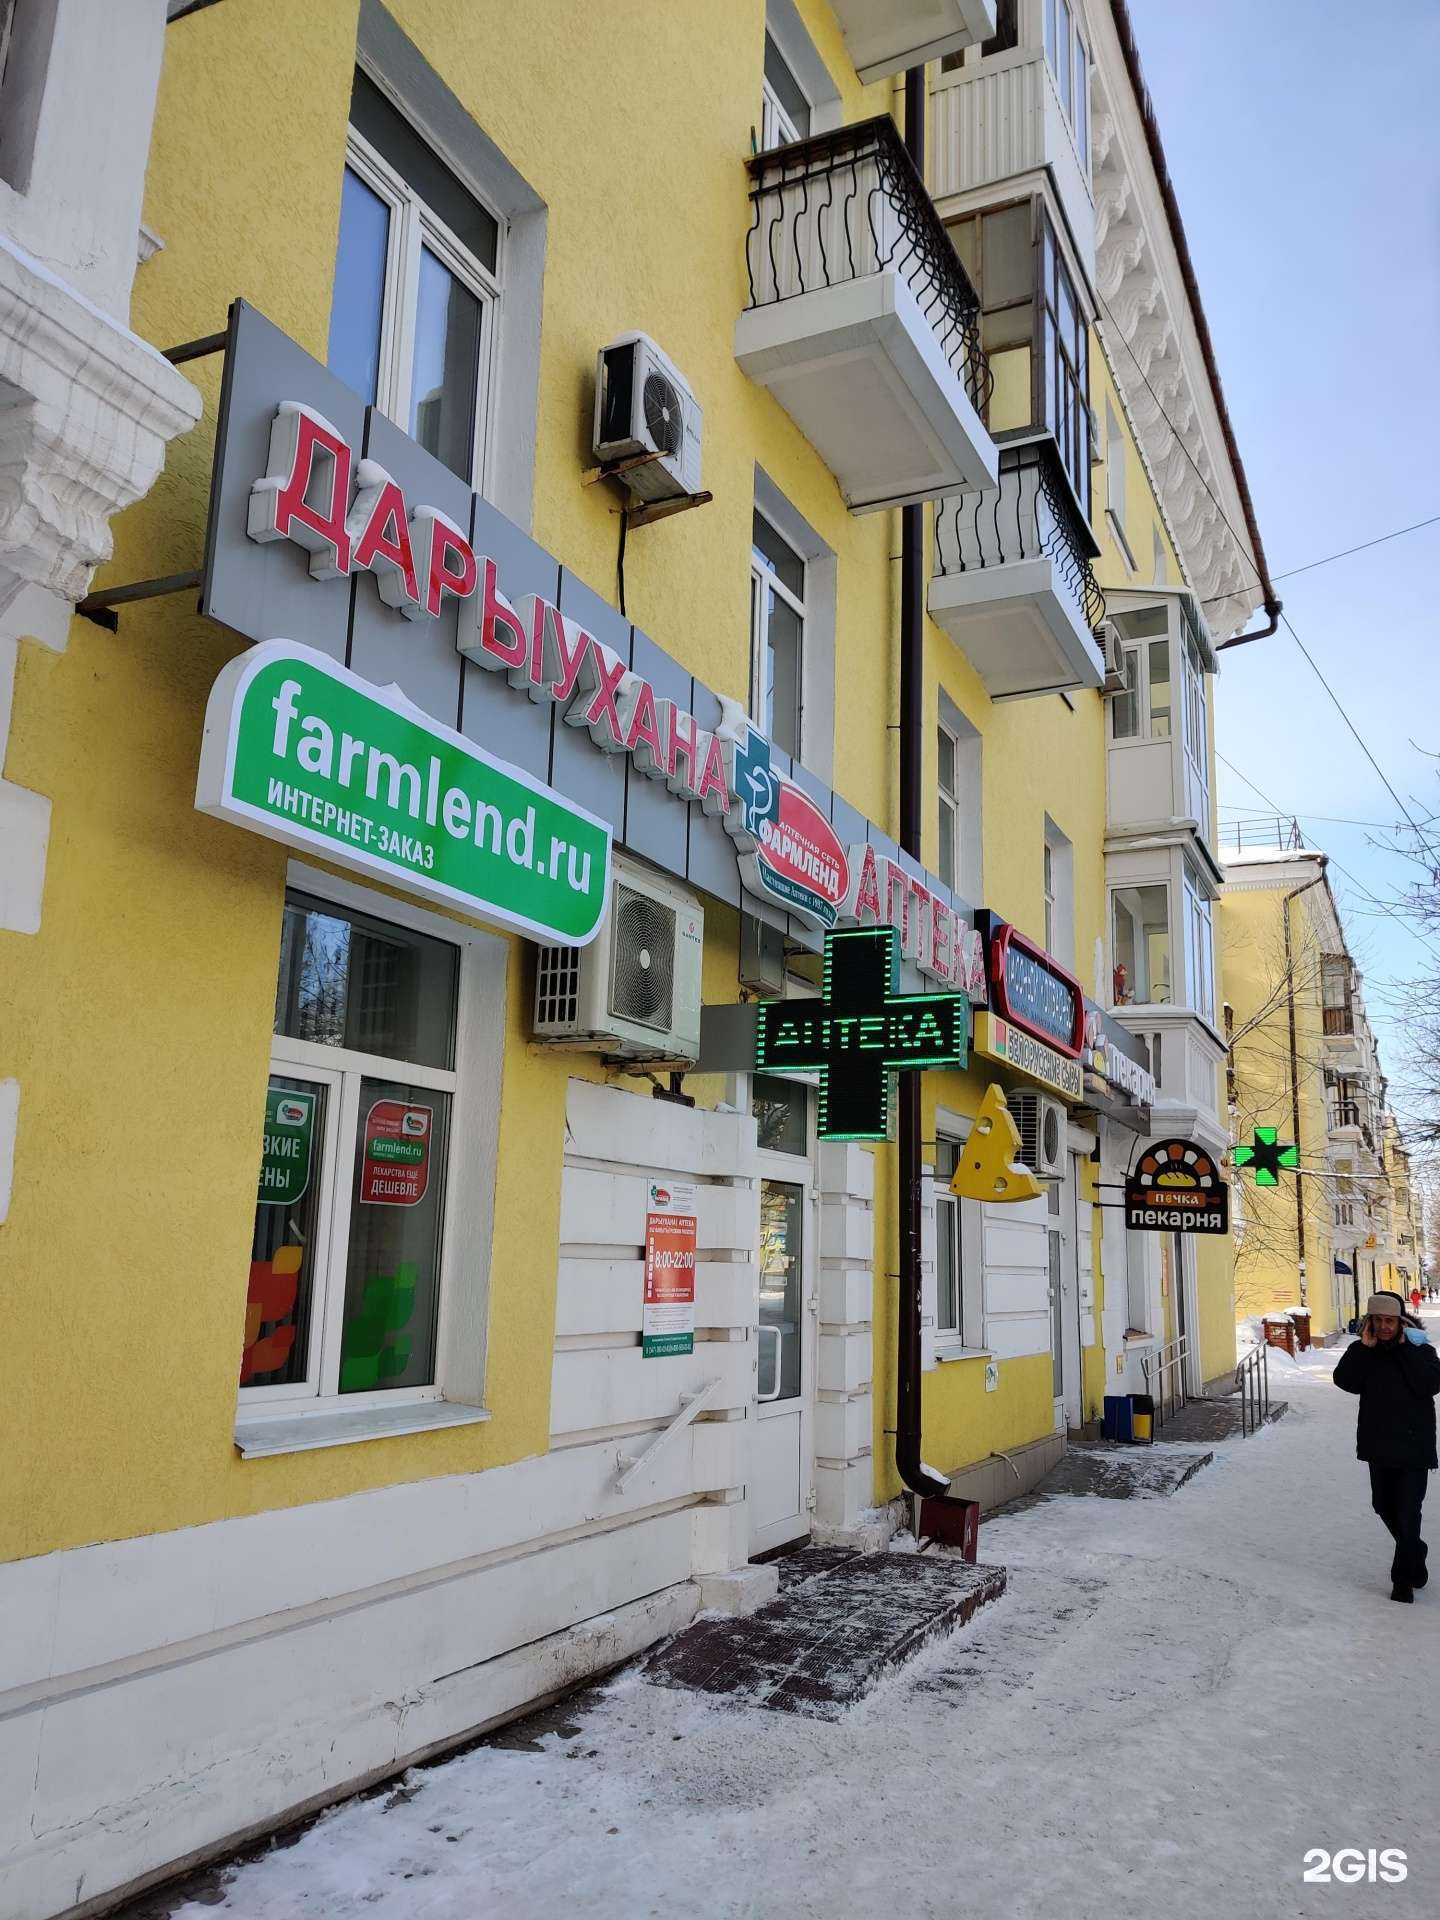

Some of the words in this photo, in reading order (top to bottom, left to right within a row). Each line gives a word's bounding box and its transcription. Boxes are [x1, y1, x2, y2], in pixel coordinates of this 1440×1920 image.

[274, 412, 731, 816] ДАРЫУХАНА
[272, 679, 592, 895] farmlend.ru
[267, 777, 435, 870] ИНТЕРНЕТ-ЗАКАЗ
[759, 818, 839, 900] ФАРМЛЕНД
[779, 821, 820, 856] АПТЕЧНАЯ
[821, 851, 840, 869] СЕТЬ
[854, 844, 988, 1005] АПТЕКА
[774, 1013, 944, 1049] АПТЕКА
[373, 1139, 422, 1157] farmlend.ru
[371, 1179, 418, 1196] ДЕШЕВЛЕ
[373, 1166, 406, 1178] ЛЕКАРСТВА
[1131, 1209, 1222, 1231] пекарня
[655, 1250, 694, 1269] 8:00-22:00
